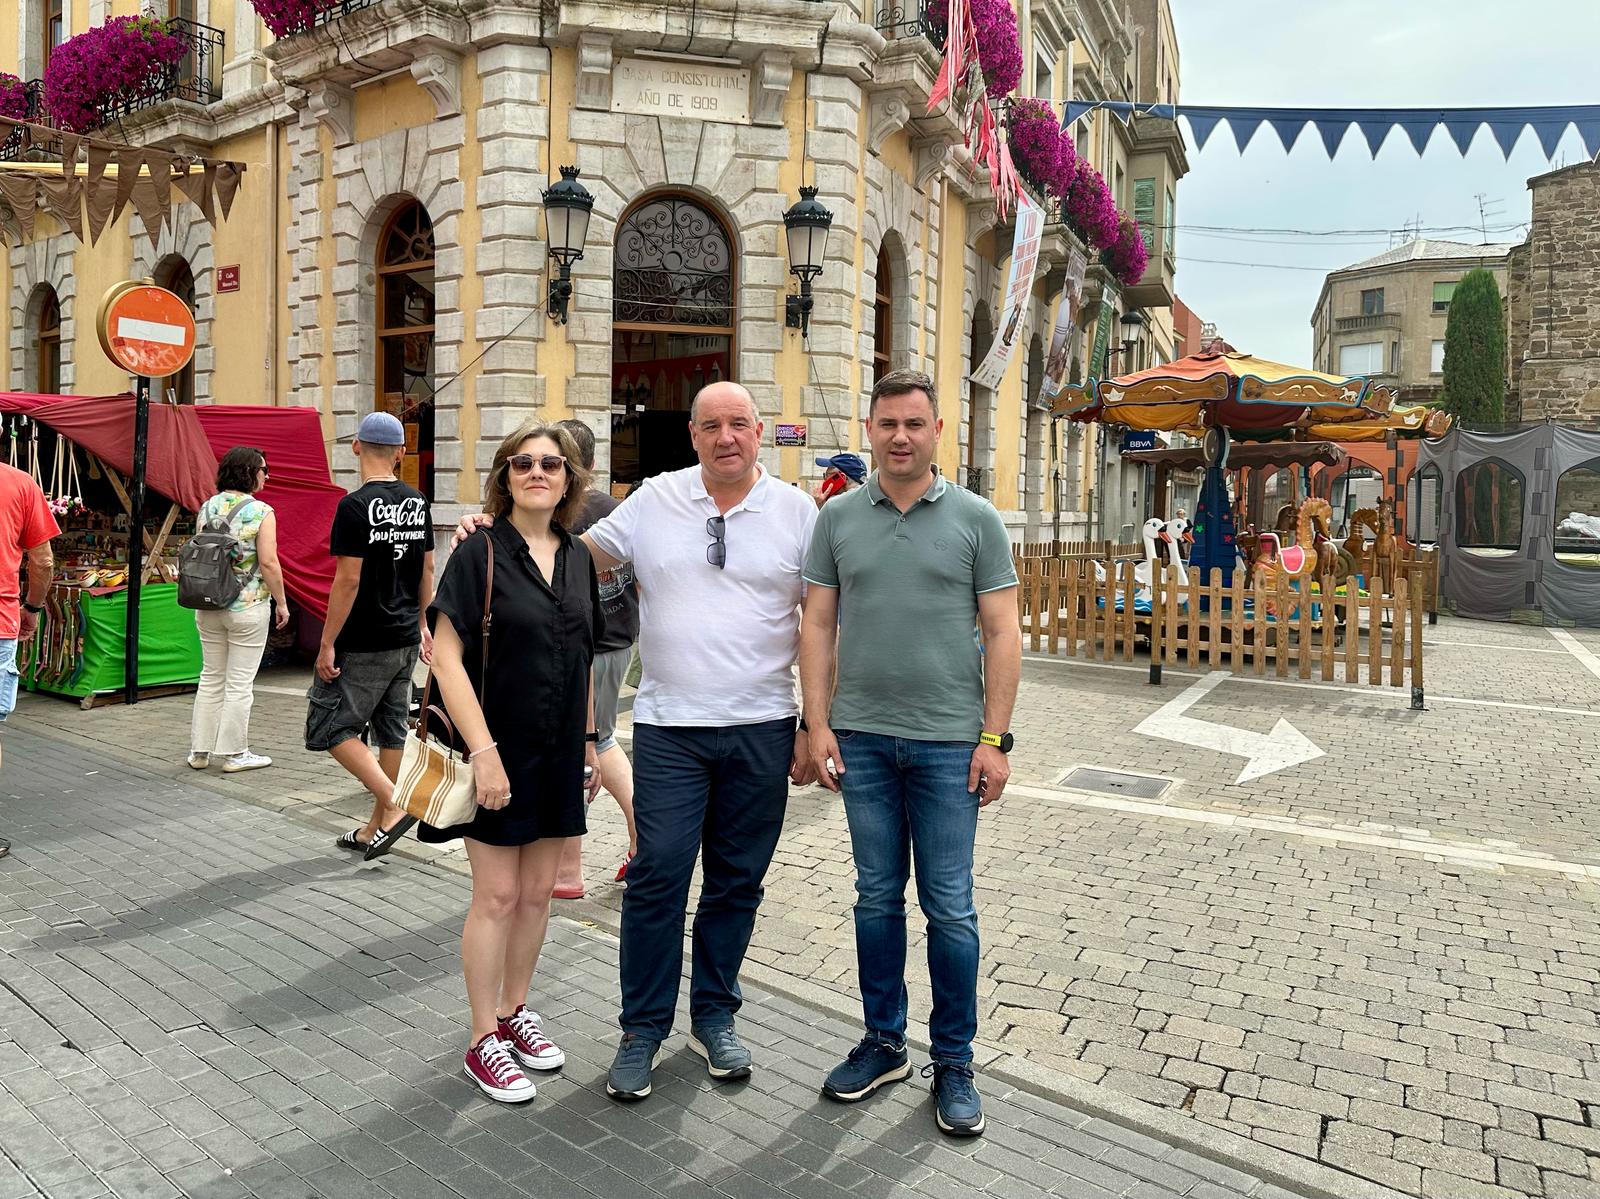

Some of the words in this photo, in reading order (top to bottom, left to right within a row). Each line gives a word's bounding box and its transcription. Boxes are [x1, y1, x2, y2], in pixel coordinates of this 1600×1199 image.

[661, 70, 744, 90] CONSISTORIAL
[637, 88, 660, 105] AÑO
[667, 93, 684, 107] DE
[690, 95, 718, 110] 1909
